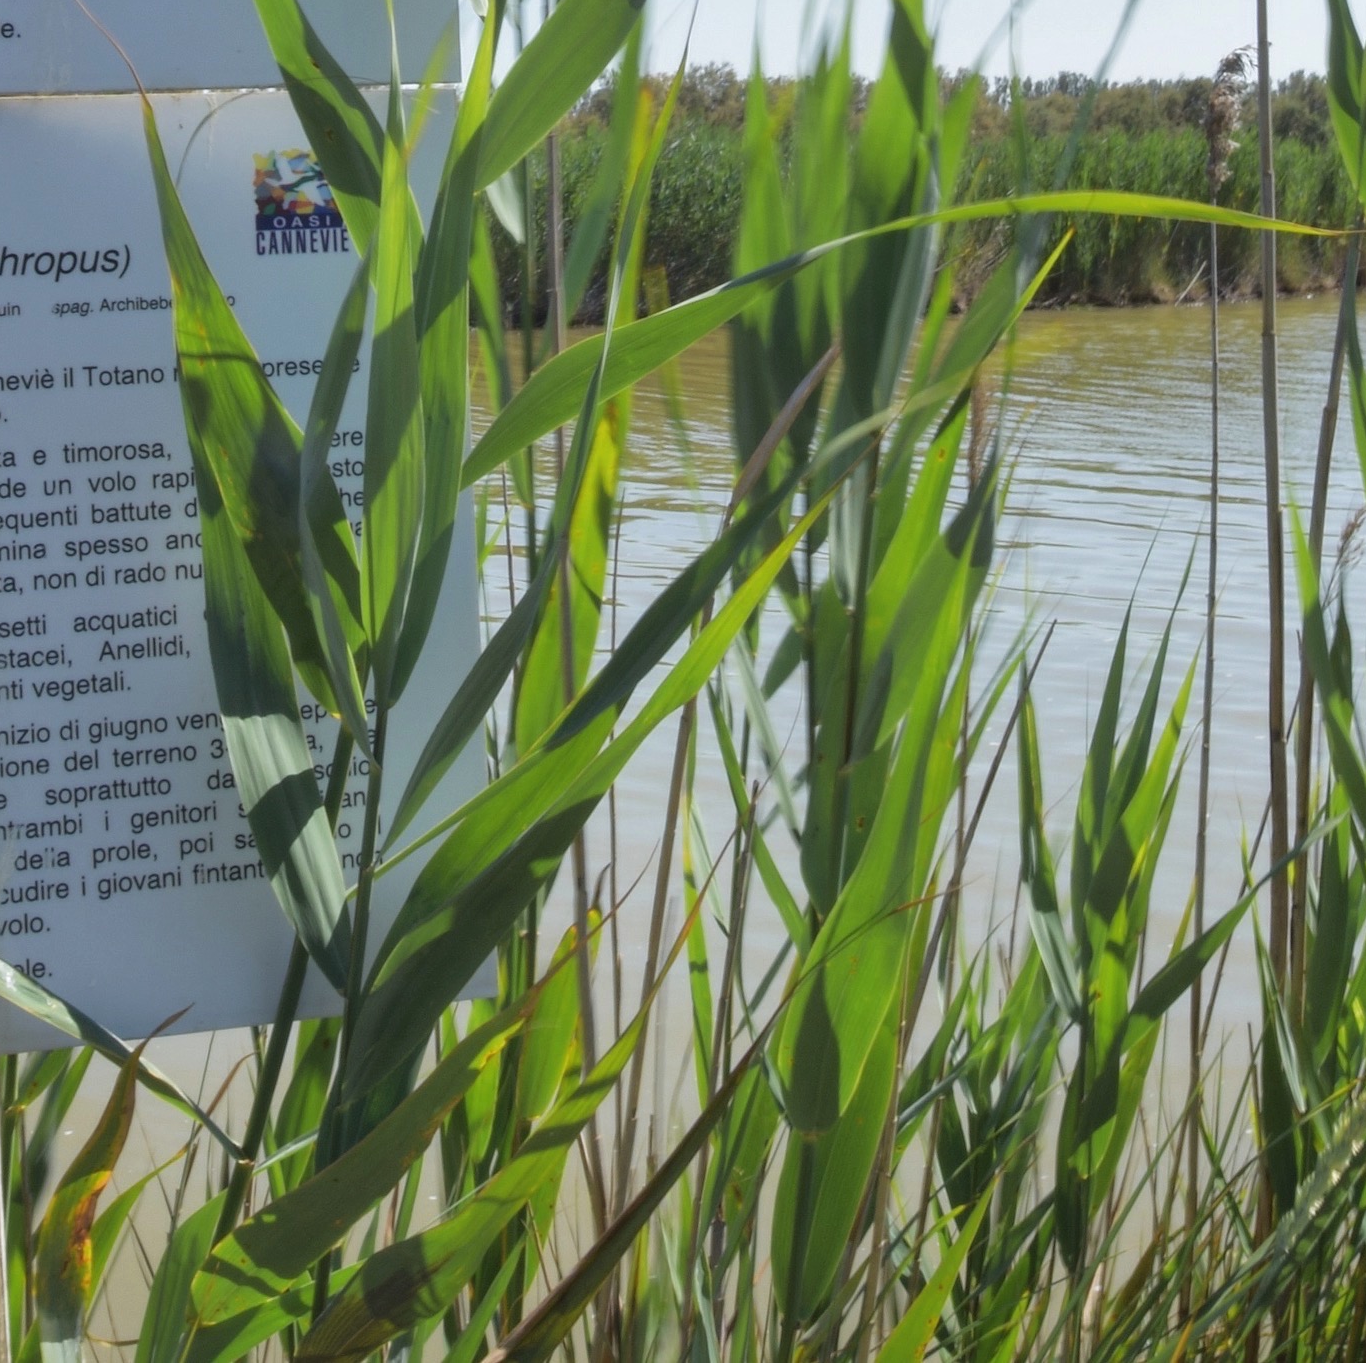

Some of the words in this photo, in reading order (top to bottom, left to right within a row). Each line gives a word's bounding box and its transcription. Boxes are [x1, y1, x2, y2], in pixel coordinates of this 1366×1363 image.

[273, 214, 331, 229] OASI
[52, 302, 93, 317] spag.
[82, 366, 164, 386] Totano
[63, 443, 171, 463] timorosa,
[88, 471, 136, 493] volo
[91, 501, 171, 524] battute
[65, 537, 148, 561] spesso
[34, 572, 77, 590] non
[115, 562, 166, 584] rado
[73, 605, 177, 635] acquatici
[99, 635, 190, 661] Anellidi,
[32, 671, 131, 701] vegetali.
[88, 717, 168, 744] giugno
[64, 749, 99, 772] del
[113, 745, 197, 768] terreno
[45, 777, 171, 808] soprattutto
[131, 801, 217, 834] genitori
[93, 840, 157, 869] prole,
[180, 832, 213, 860] poi
[98, 866, 181, 900] giovani
